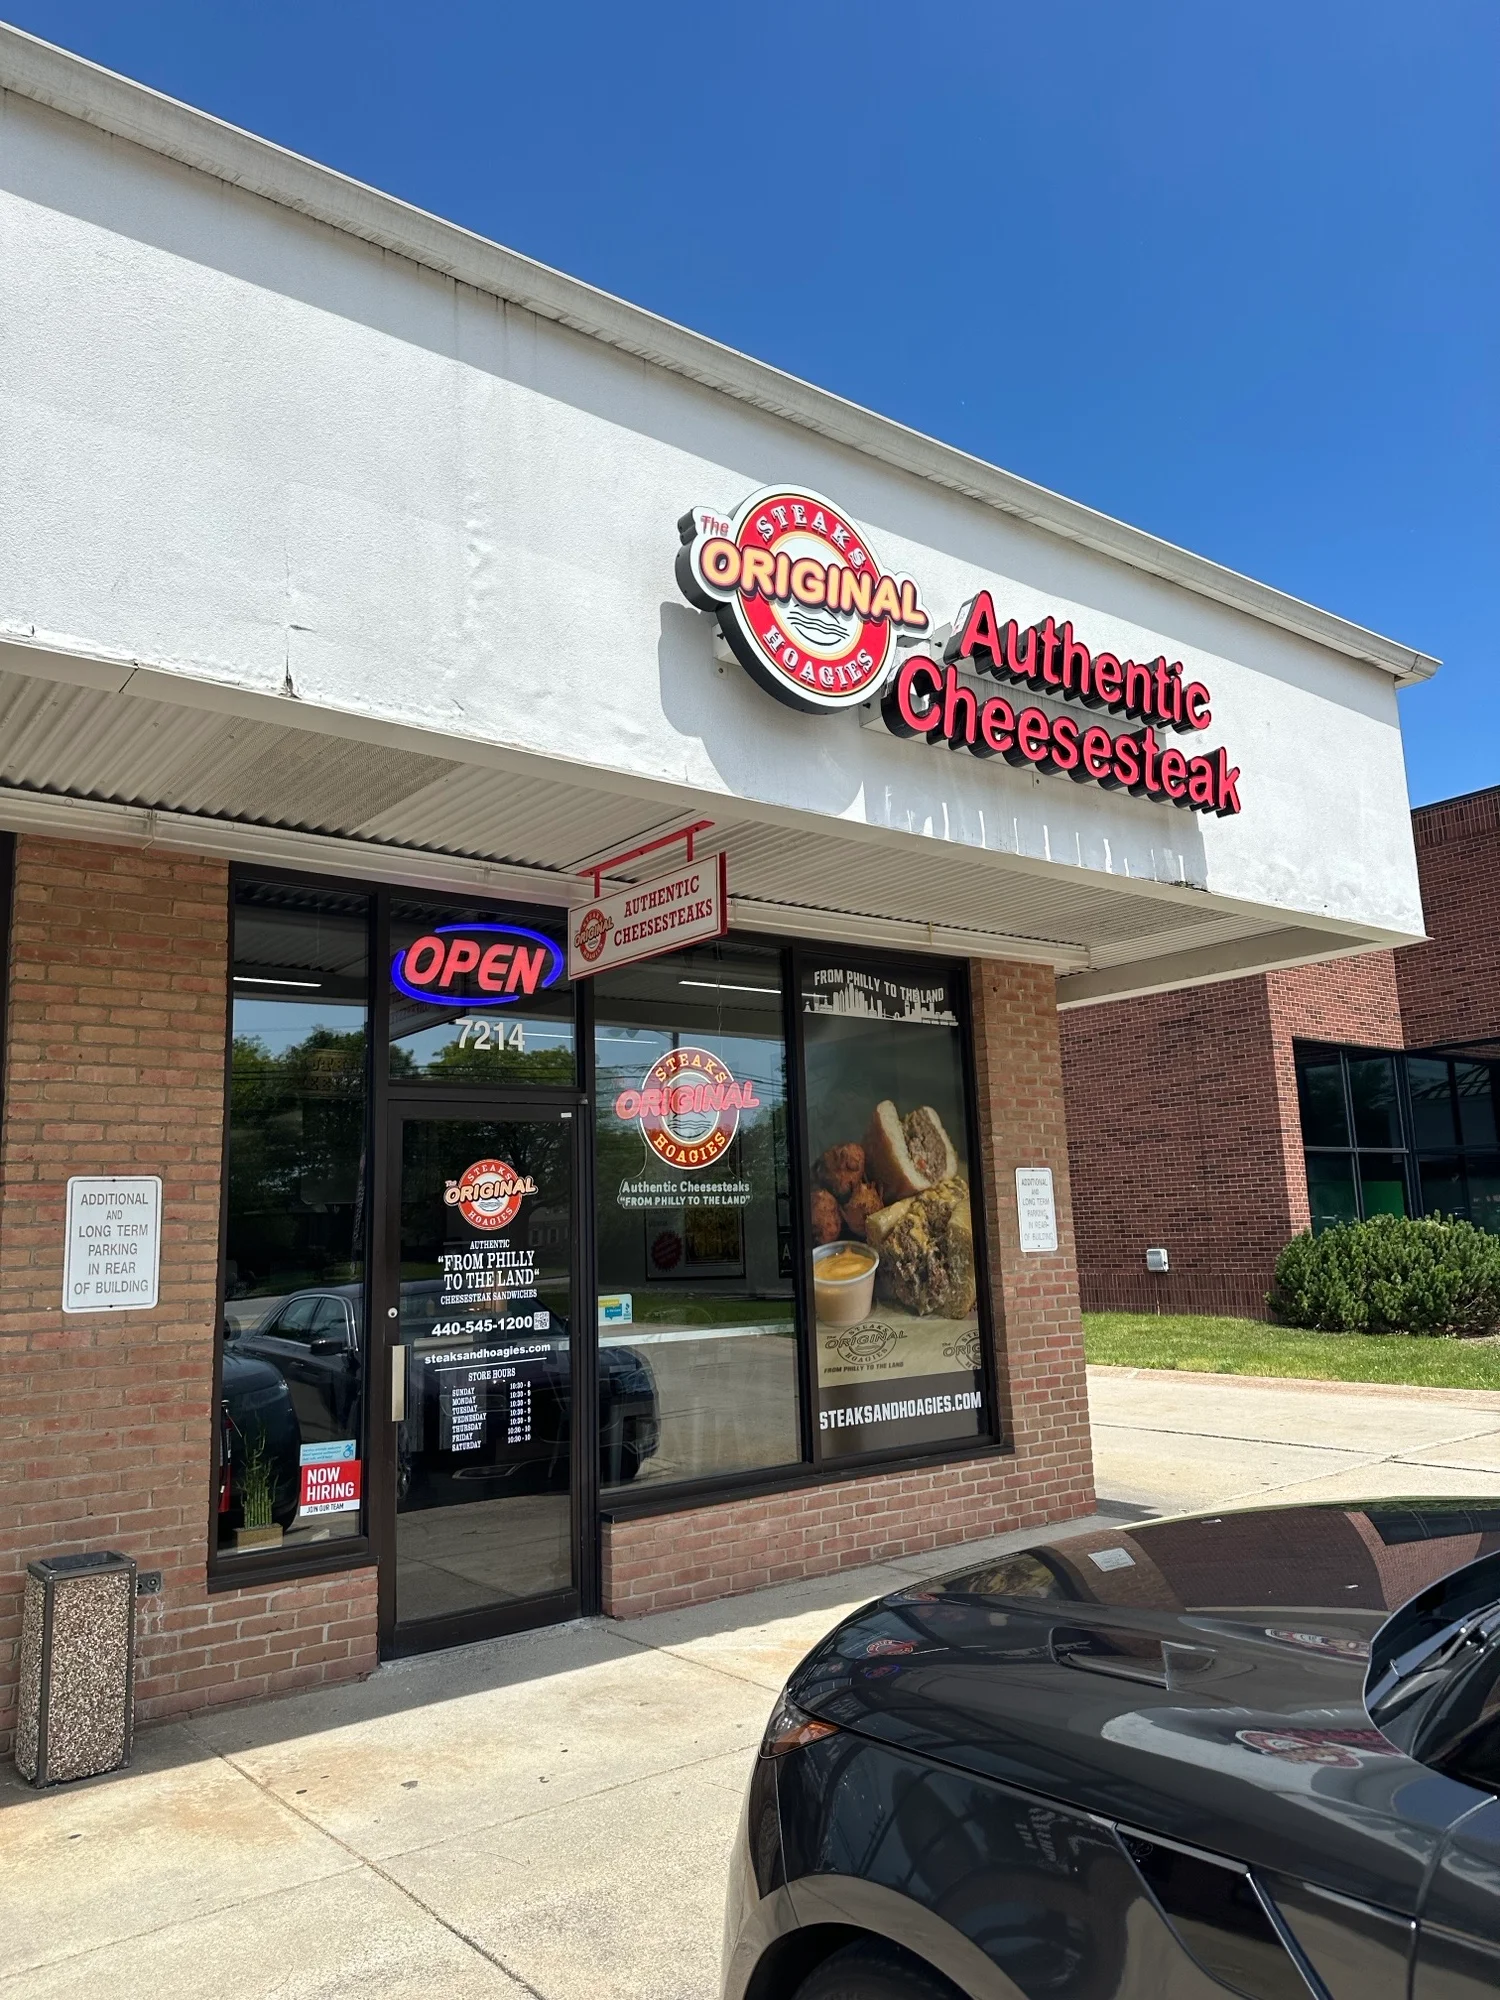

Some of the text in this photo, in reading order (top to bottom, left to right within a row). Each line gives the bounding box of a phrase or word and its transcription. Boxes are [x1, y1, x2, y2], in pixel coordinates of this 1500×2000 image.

[702, 515, 729, 537] The
[757, 504, 866, 568] STEAKS
[700, 537, 929, 630] ORIGINAL
[763, 625, 874, 689] HOAGIES
[960, 590, 1212, 730] Authentic
[898, 655, 1241, 815] Cheesesteak
[624, 875, 700, 918] AUTHENTIC
[614, 898, 713, 946] CHEESESTEAKS
[574, 916, 614, 948] ORIGINAL
[403, 935, 548, 995] OPEN
[814, 969, 944, 1004] FROM PHILLY TO THE LAND
[456, 1019, 526, 1052] 7214
[655, 1053, 727, 1084] STEAKS
[615, 1081, 760, 1120] ORIGINAL
[654, 1131, 726, 1163] HOAGIES
[468, 1164, 512, 1181] STEAKS
[445, 1177, 537, 1204] ORIGINAL
[622, 1181, 750, 1193] Authentic Cheesesteaks
[1021, 1178, 1048, 1186] ADDITIONAL
[81, 1193, 148, 1206] ADDITIONAL
[620, 1196, 751, 1206] “FROM PHILLY TO THE LAND”
[1022, 1198, 1050, 1206] LONG TERM
[106, 1210, 123, 1220] AND
[468, 1207, 513, 1226] HOAGIES
[79, 1224, 149, 1238] LONG TERM
[1032, 1232, 1053, 1241] BUILDING
[88, 1243, 138, 1257] PARKING
[469, 1239, 510, 1250] AUTHENTIC
[88, 1262, 136, 1276] IN REAR
[438, 1251, 535, 1271] “FROM PHILLY
[74, 1280, 148, 1295] OF BUILDING
[444, 1273, 463, 1290] TO
[466, 1271, 495, 1289] THE
[440, 1289, 538, 1305] CHEESESTEAK SANDWICHES
[431, 1316, 533, 1337] 440-545-1200
[848, 1323, 890, 1335] STEAKS
[824, 1330, 908, 1350] ORIGINAL
[424, 1344, 551, 1365] steaksandhoagies.com
[845, 1348, 888, 1363] HOAGIES
[468, 1367, 516, 1382] STORE HOURS
[452, 1387, 475, 1397] SUNDAY
[452, 1396, 477, 1406] MONDAY
[452, 1405, 478, 1415] TUESDAY
[452, 1413, 487, 1424] WEDNESDAY
[819, 1391, 982, 1430] STEAKSANDHOAGIES.COM
[452, 1422, 482, 1433] THURSDAY
[452, 1433, 473, 1442] FRIDAY
[452, 1441, 481, 1452] SATURDAY
[307, 1467, 340, 1485] NOW
[306, 1481, 355, 1502] HIRING
[306, 1506, 318, 1514] JOIN
[331, 1502, 344, 1510] TEAM
